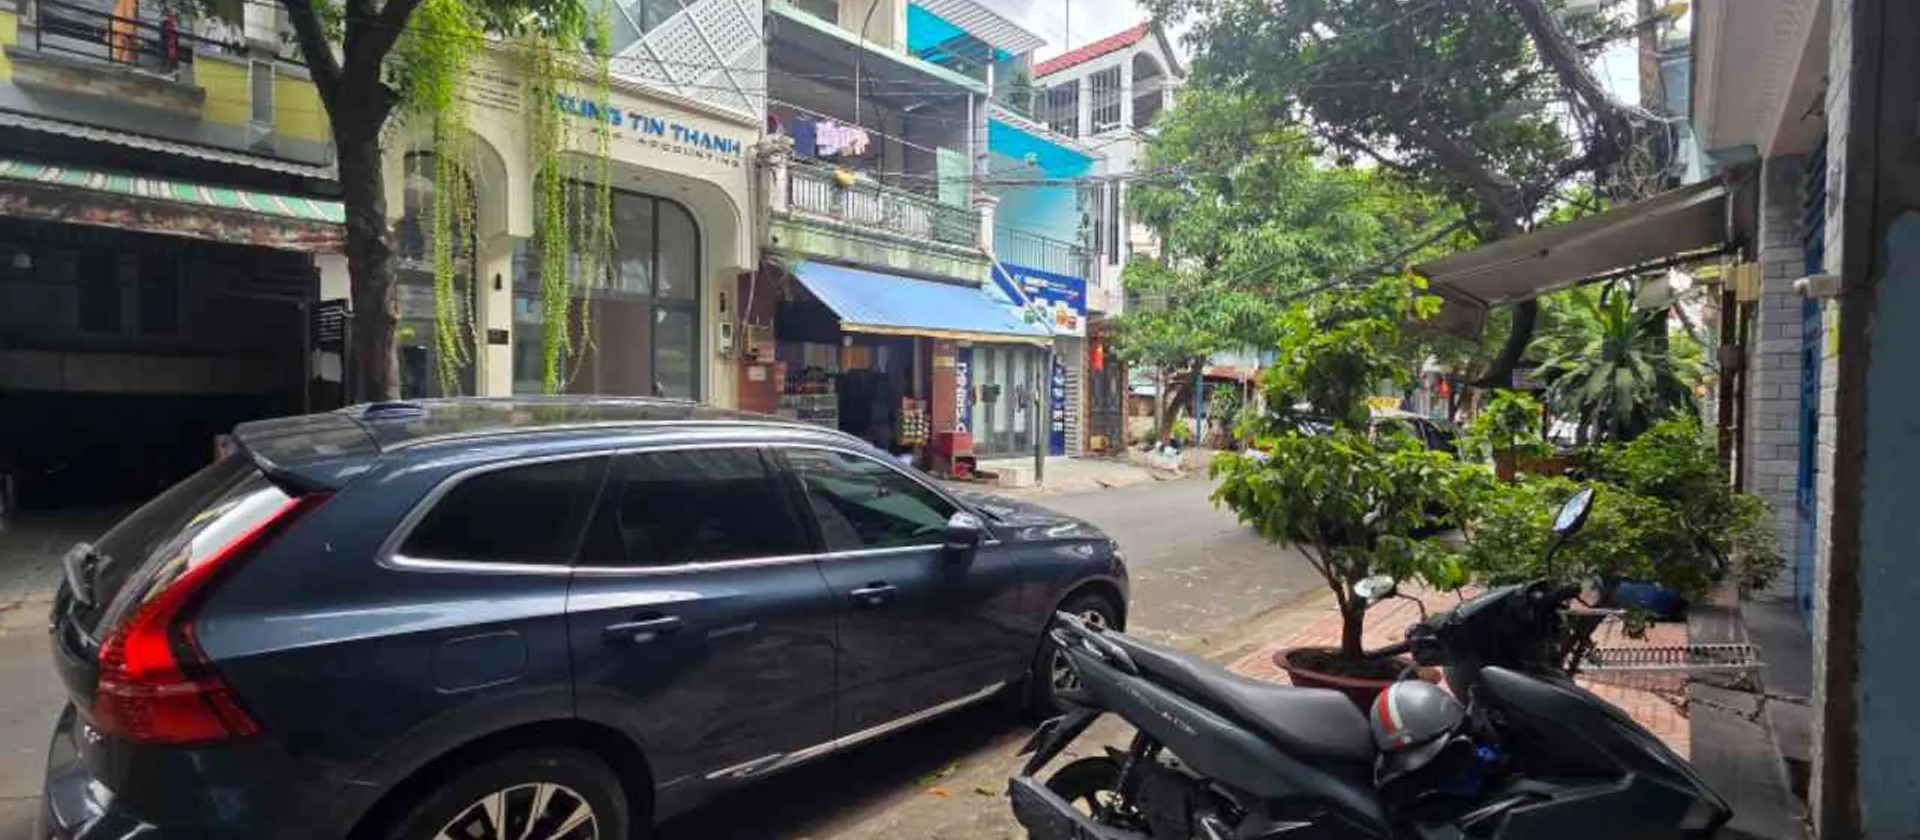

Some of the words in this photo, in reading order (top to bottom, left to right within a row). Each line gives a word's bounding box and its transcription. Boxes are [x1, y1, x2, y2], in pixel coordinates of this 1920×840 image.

[554, 93, 624, 126] RUNG
[627, 111, 665, 136] TIN
[670, 123, 742, 157] THANH
[637, 137, 741, 168] ACCOUNTING
